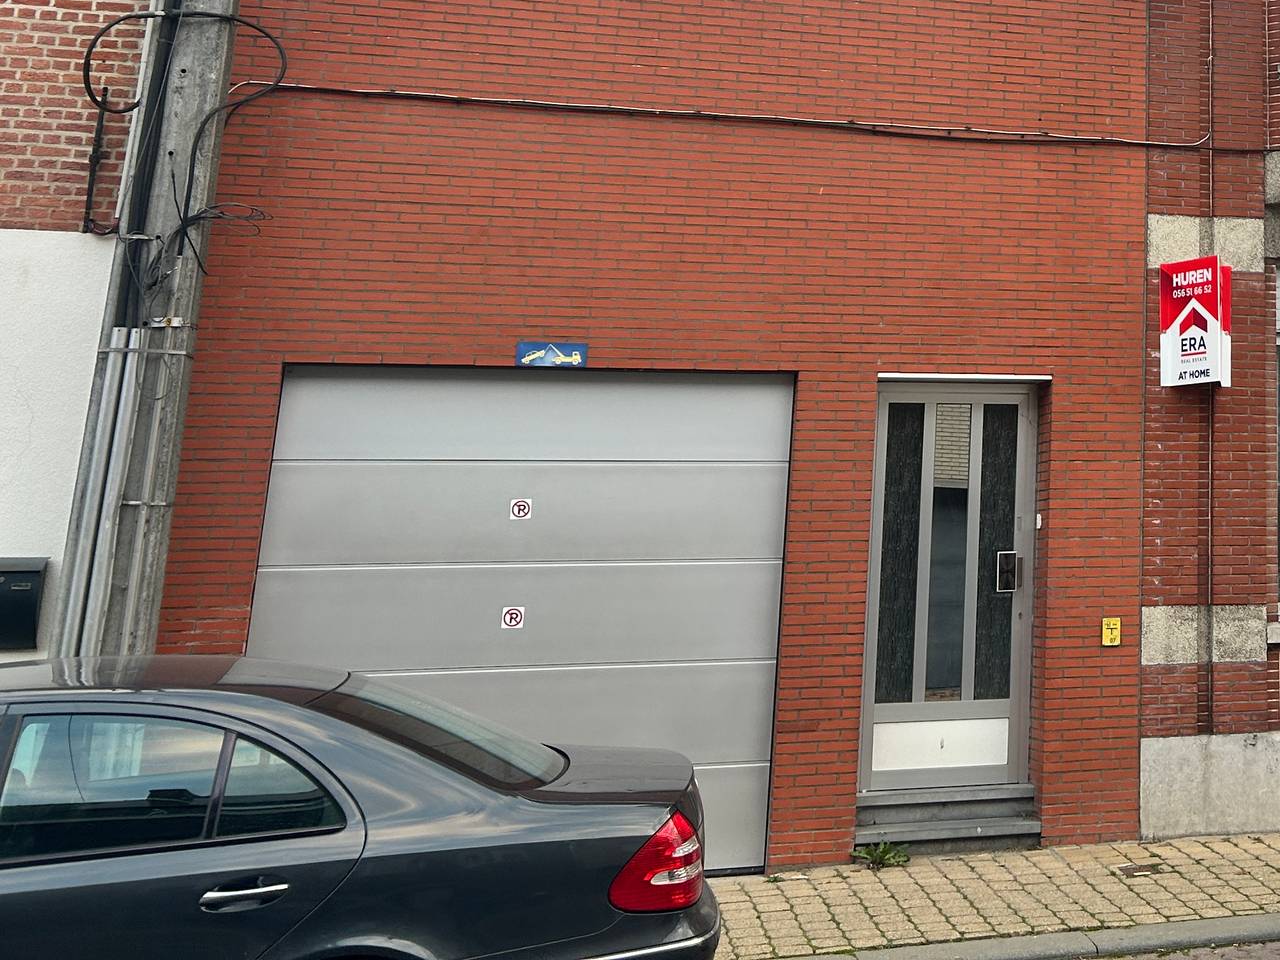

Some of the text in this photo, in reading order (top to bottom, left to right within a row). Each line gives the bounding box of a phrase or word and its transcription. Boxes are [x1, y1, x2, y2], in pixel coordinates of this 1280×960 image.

[1173, 268, 1212, 287] HUREN
[1173, 285, 1212, 298] 056 51 66 52
[1181, 336, 1206, 352] ERA
[1178, 368, 1210, 381] AT HOME
